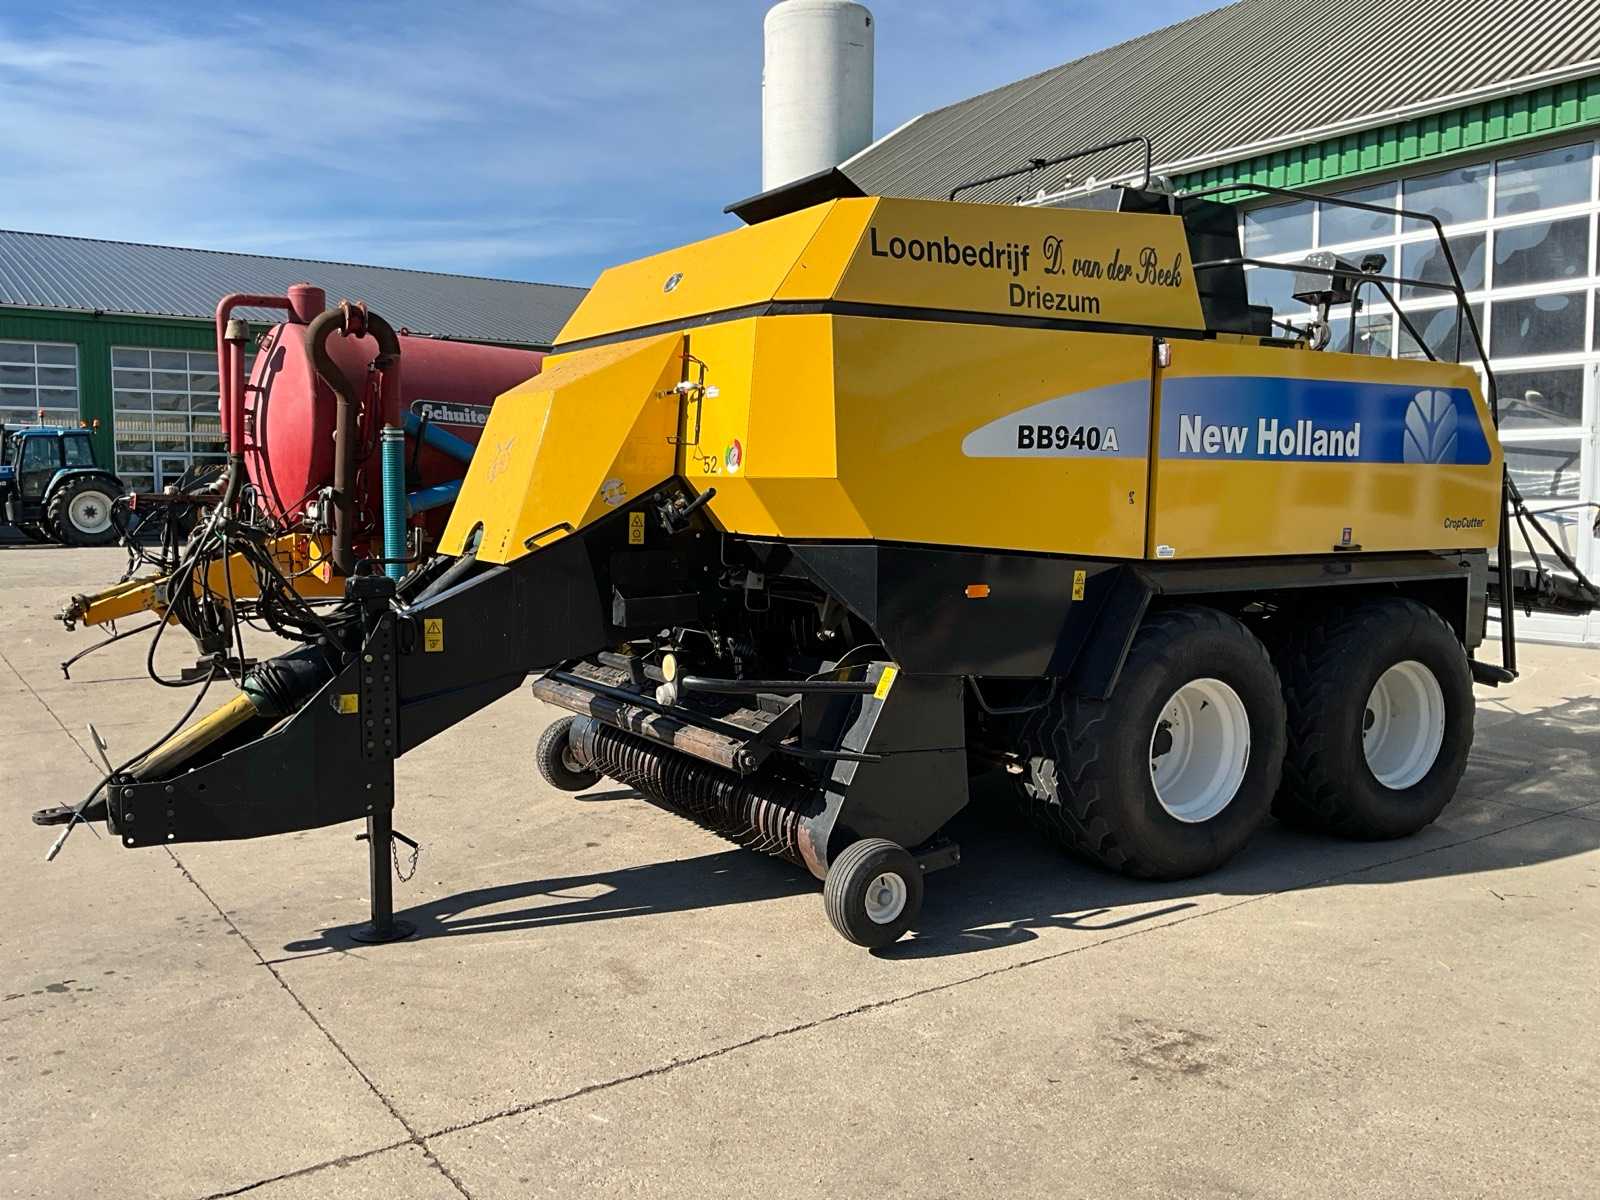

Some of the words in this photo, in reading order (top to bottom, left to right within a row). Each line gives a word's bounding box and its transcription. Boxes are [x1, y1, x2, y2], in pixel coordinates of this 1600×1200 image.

[870, 227, 1030, 277] Loonbedrijf
[1043, 235, 1065, 275] D.
[1072, 256, 1103, 280] van
[1106, 248, 1132, 281] der
[1136, 246, 1182, 288] Beek
[1009, 283, 1100, 314] Driezum
[421, 403, 489, 424] Schuite
[1017, 424, 1120, 452] BB940A
[1179, 414, 1249, 454] New
[1257, 417, 1361, 457] Holland
[703, 455, 717, 474] 52
[1443, 516, 1485, 531] CropCutter
